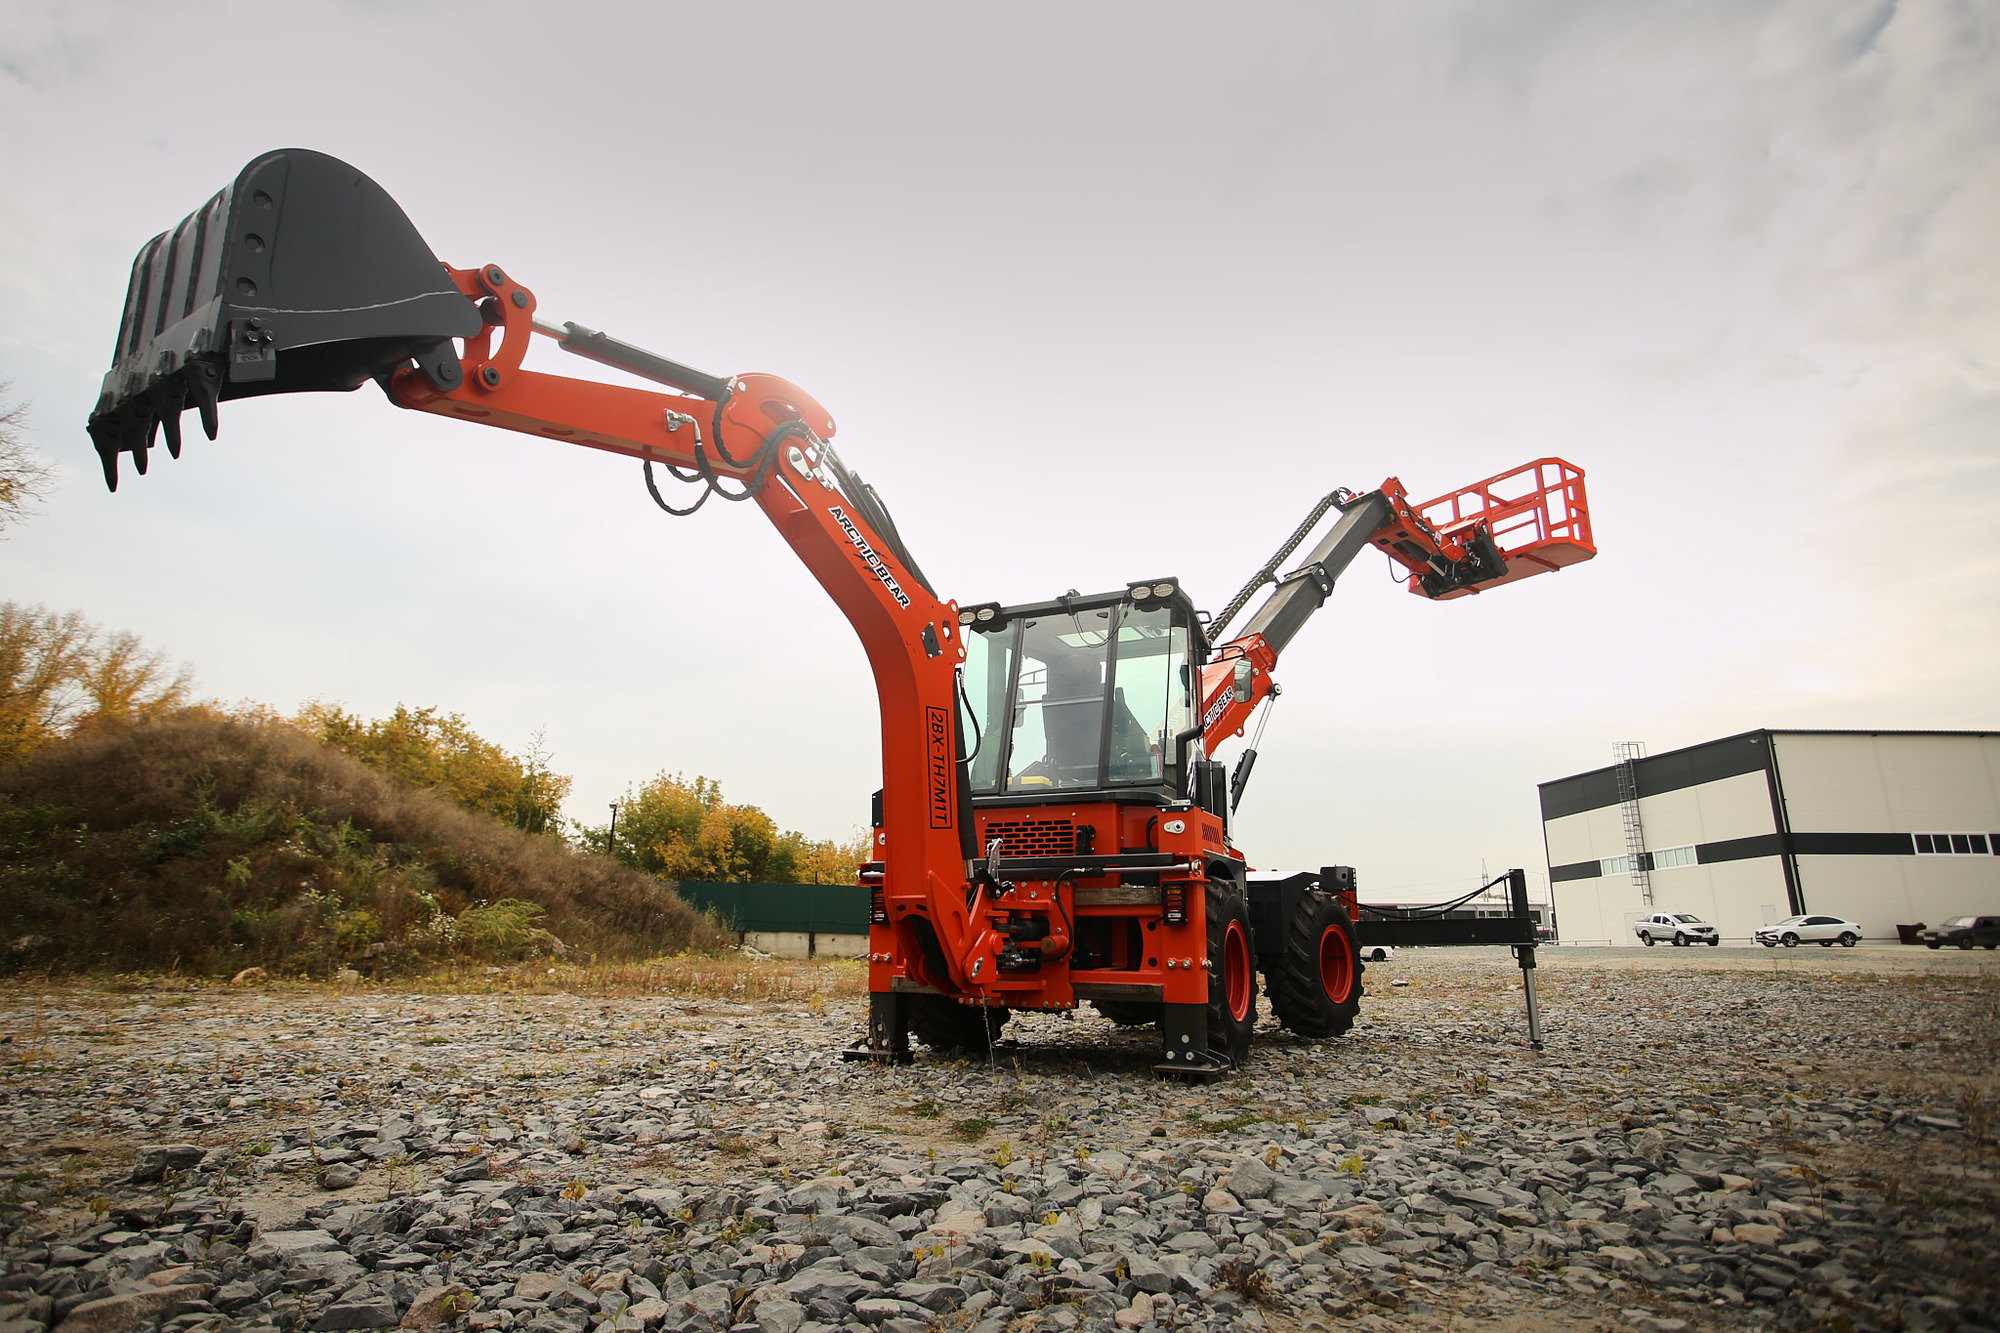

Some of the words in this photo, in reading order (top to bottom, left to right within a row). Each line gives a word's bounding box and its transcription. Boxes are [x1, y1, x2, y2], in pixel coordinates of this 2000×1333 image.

[829, 506, 880, 566] ARCTIC
[875, 564, 910, 608] BEAR
[1217, 686, 1234, 711] BEAR
[931, 711, 948, 824] 2BX-TH7M1T
